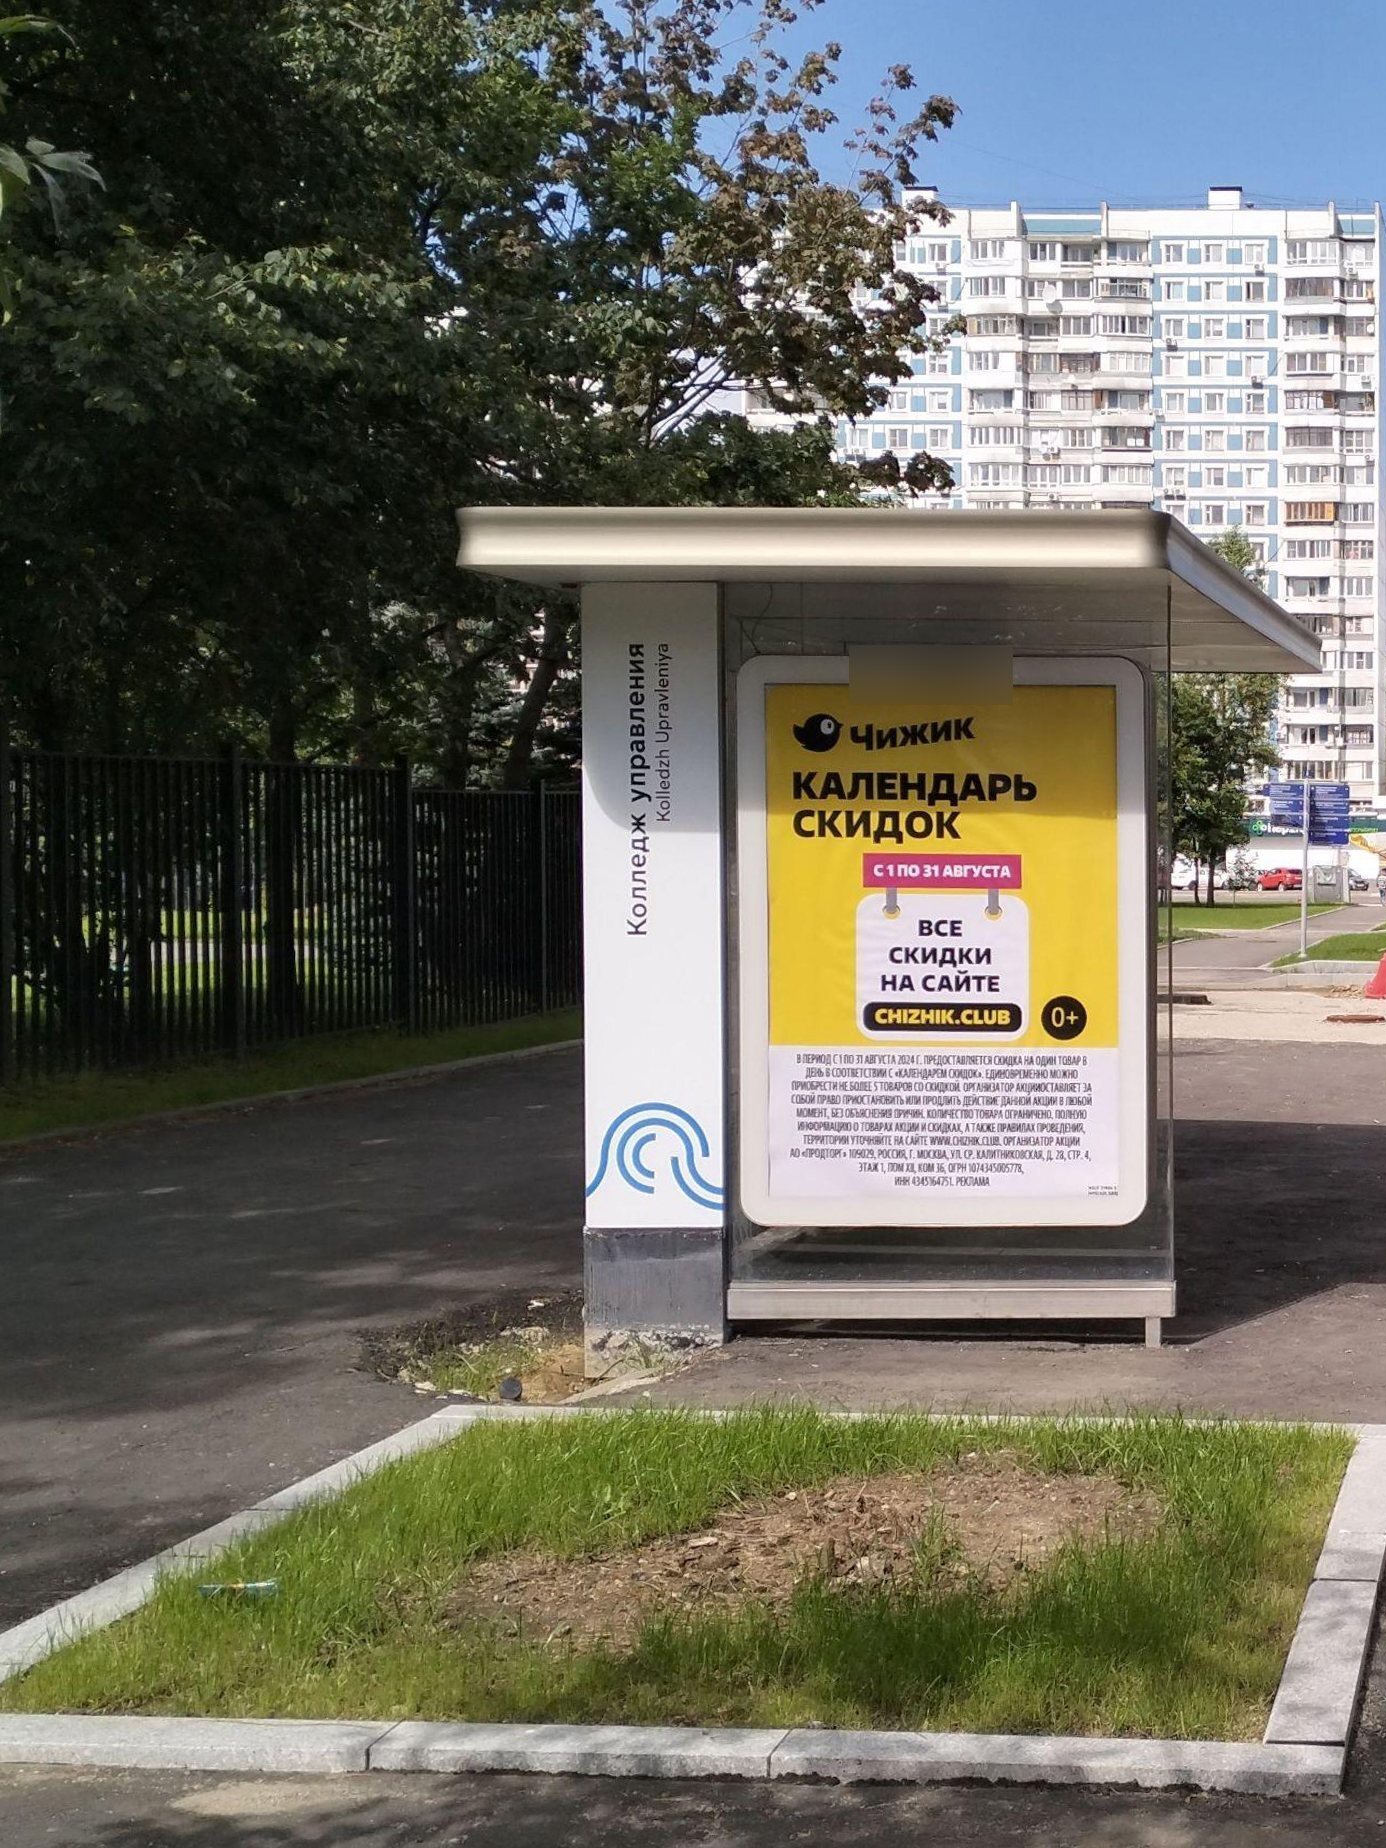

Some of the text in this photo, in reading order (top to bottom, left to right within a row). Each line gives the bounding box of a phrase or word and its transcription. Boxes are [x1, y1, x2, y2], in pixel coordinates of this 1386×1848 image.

[655, 643, 673, 822] Kolledzh Upravleniya
[627, 643, 651, 936] Колледж управления
[792, 771, 1038, 806] КАЛЕНДАРЬ
[792, 809, 962, 844] СКИДОК
[873, 866, 1011, 878] С 1 ПО 31 АВГУСТА
[918, 919, 963, 937] ВСЕ
[889, 947, 992, 967] СКИДКИ
[881, 970, 1000, 993] НА САЙТЕ
[874, 1008, 1011, 1025] CHIZHIK.CLUB
[1051, 1007, 1079, 1028] 0+
[797, 1054, 801, 1064] В
[803, 1054, 831, 1065] ПЕРИОД
[833, 1054, 838, 1064] С
[844, 1054, 854, 1064] ПО
[856, 1054, 863, 1064] 31
[865, 1055, 895, 1064] АВГУСТА
[898, 1055, 914, 1064] 2024
[994, 1055, 1022, 1066] СКИДКА
[1024, 1056, 1034, 1065] НА
[1036, 1056, 1056, 1067] ОДИН
[1058, 1056, 1081, 1065] ТОВАР
[1083, 1056, 1087, 1066] В
[806, 1068, 824, 1079] ДЕНЬ
[826, 1068, 830, 1078] В
[889, 1068, 893, 1078] С
[1050, 1069, 1078, 1079] МОЖНО
[839, 1081, 848, 1091] НЕ
[850, 1081, 872, 1091] БОЛЕЕ
[874, 1082, 878, 1091] 5
[880, 1082, 912, 1091] ТОВАРОВ
[914, 1082, 923, 1091] СО
[1083, 1083, 1092, 1092] ЗА
[791, 1093, 815, 1104] СОБОЙ
[817, 1095, 841, 1104] ПРАВО
[906, 1095, 921, 1105] ИЛИ
[923, 1095, 961, 1107] ПРОДЛИТЬ
[963, 1094, 1000, 1107] ДЕЙСТВИЕ
[1001, 1094, 1031, 1107] ДАННОЙ
[1033, 1096, 1058, 1107] АКЦИИ
[1059, 1096, 1063, 1106] В
[1065, 1094, 1092, 1106] ЛЮБОЙ
[797, 1108, 829, 1119] МОМЕНТ,
[831, 1108, 843, 1118] БЕЗ
[976, 1109, 1003, 1119] ТОВАРА
[1055, 1110, 1087, 1119] ПОЛНУЮ
[853, 1122, 858, 1132] О
[861, 1122, 893, 1132] ТОВАРАХ
[895, 1122, 919, 1134] АКЦИИ
[921, 1123, 926, 1132] И
[928, 1123, 963, 1134] СКИДКАХ,
[965, 1123, 970, 1132] А
[971, 1123, 995, 1133] ТАКЖЕ
[997, 1123, 1035, 1133] ПРАВИЛАХ
[851, 1133, 891, 1145] УТОЧНЯЙТЕ
[894, 1135, 904, 1145] НА
[906, 1133, 927, 1145] САЙТЕ
[1056, 1136, 1080, 1148] АКЦИИ
[790, 1148, 799, 1158] АО
[878, 1149, 908, 1160] РОССИЯ,
[917, 1149, 948, 1160] МОСКВА,
[1068, 1150, 1083, 1160] СТР.
[1084, 1150, 1091, 1161] 4,
[859, 1163, 879, 1172] ЭТАЖ
[881, 1163, 886, 1174] 1,
[888, 1163, 904, 1172] ПОМ
[918, 1163, 934, 1173] КОМ
[948, 1163, 966, 1173] ОГРН
[894, 1176, 909, 1186] ИНН
[956, 1177, 989, 1186] РЕКЛАМА
